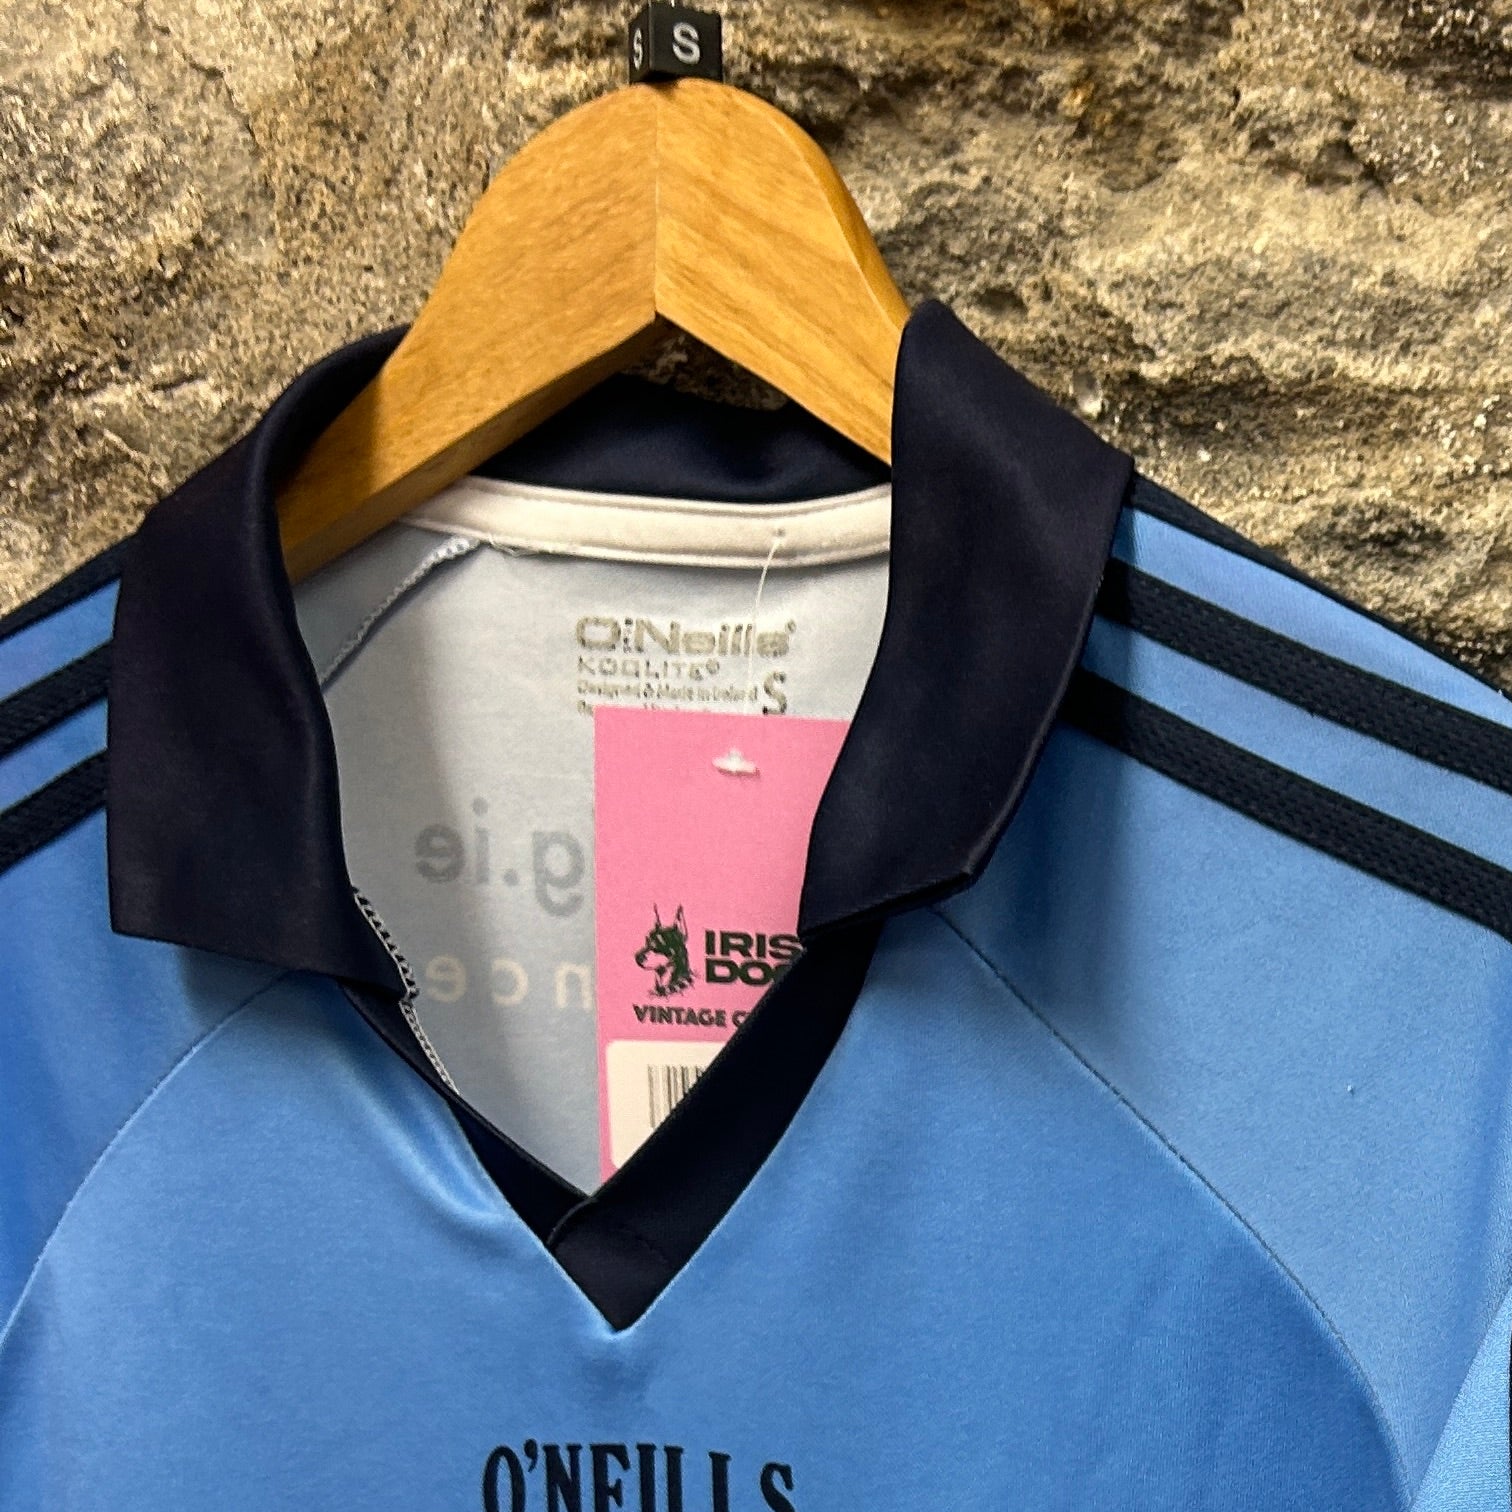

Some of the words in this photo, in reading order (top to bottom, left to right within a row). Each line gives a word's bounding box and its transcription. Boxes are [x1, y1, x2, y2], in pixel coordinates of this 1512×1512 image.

[672, 22, 701, 65] S
[761, 671, 788, 716] S
[704, 929, 802, 960] IRIS
[632, 1003, 728, 1029] VINTAGE
